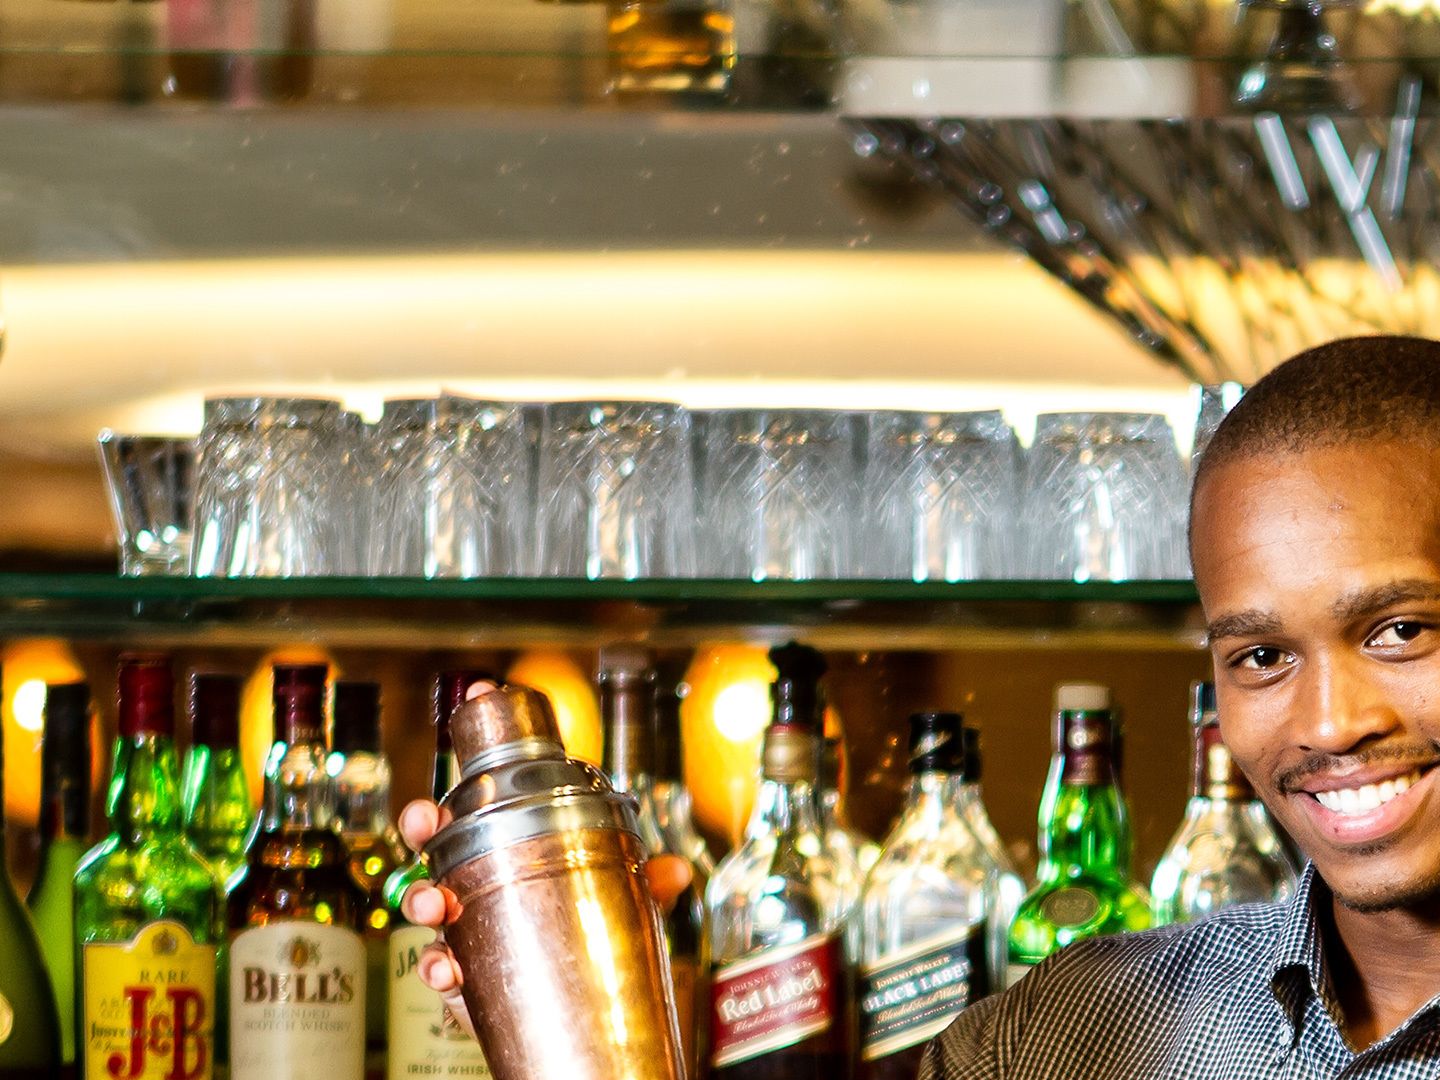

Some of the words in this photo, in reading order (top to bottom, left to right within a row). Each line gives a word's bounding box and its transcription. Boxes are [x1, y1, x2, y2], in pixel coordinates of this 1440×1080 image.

[914, 955, 951, 977] WALKER
[140, 968, 190, 983] RARE
[243, 965, 355, 1004] BELL'S
[721, 988, 764, 1022] Red
[263, 1007, 331, 1019] BLENDED
[243, 1021, 297, 1033] SCOTCH
[406, 1063, 443, 1075] IRISH
